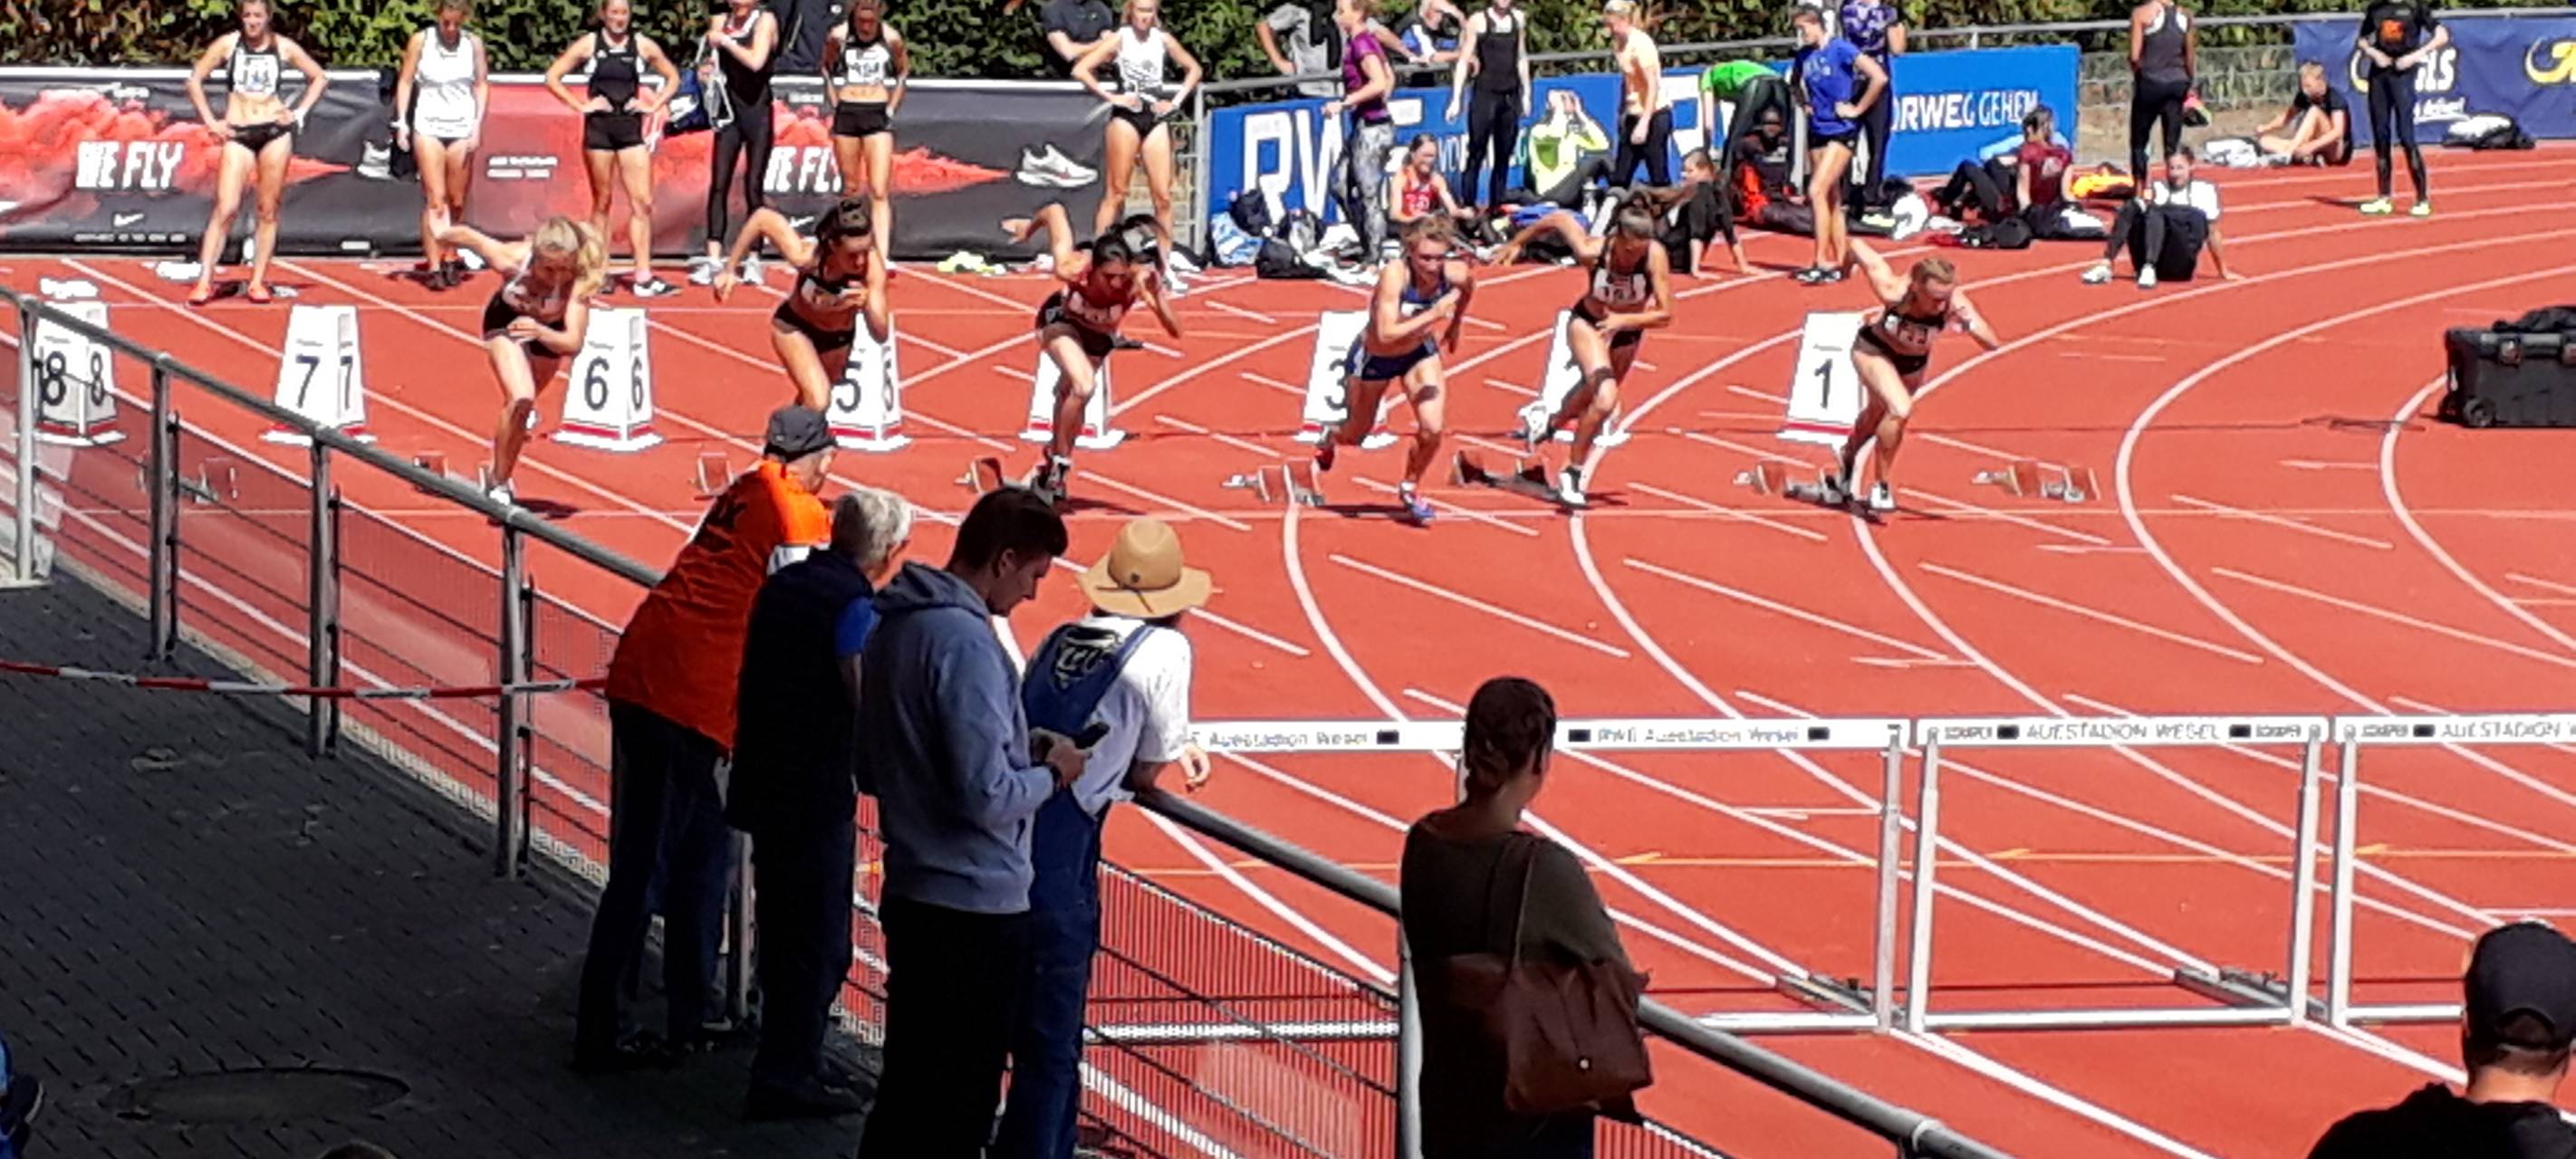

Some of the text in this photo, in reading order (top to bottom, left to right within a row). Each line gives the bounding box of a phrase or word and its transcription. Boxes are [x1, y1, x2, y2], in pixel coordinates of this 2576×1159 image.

[75, 140, 184, 189] WE FLY
[43, 350, 67, 407] 8
[91, 350, 105, 407] 8
[295, 354, 321, 408] 7
[584, 357, 610, 411] 6
[631, 357, 644, 412] 6
[835, 360, 861, 413] 5
[1324, 359, 1350, 412] 3
[1814, 358, 1833, 409] 1
